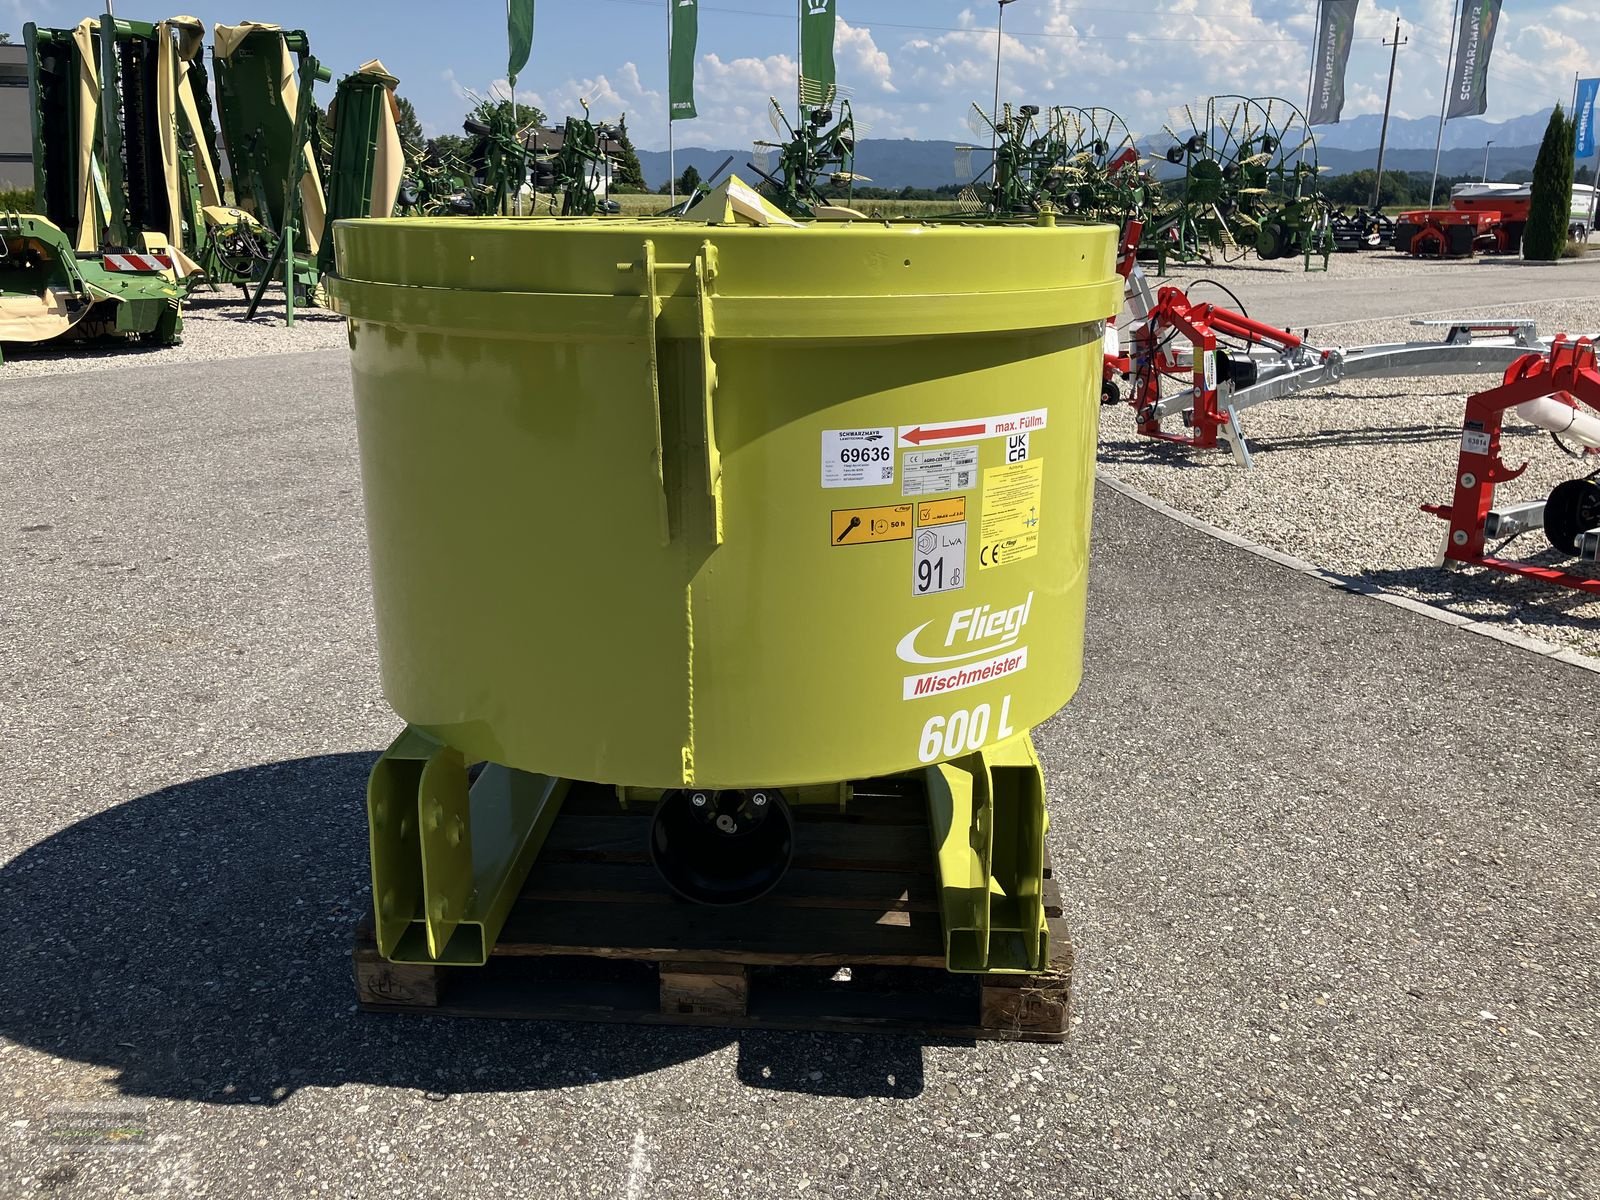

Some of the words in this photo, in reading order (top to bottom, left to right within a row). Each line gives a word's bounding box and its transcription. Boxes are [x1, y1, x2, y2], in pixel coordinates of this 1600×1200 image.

[1320, 23, 1338, 110] SCHWARZMAYR
[1460, 6, 1483, 101] SCHWARZMAYR
[995, 420, 1017, 433] max.
[1019, 415, 1044, 429] Füllm.
[1008, 434, 1026, 449] UK
[840, 447, 890, 463] 69636
[1008, 448, 1026, 462] CA
[917, 557, 944, 592] 91
[949, 568, 961, 586] dB
[944, 590, 1034, 647] Fliegl
[913, 655, 1023, 696] Mischmeister
[918, 703, 991, 763] 600
[997, 694, 1013, 739] L
